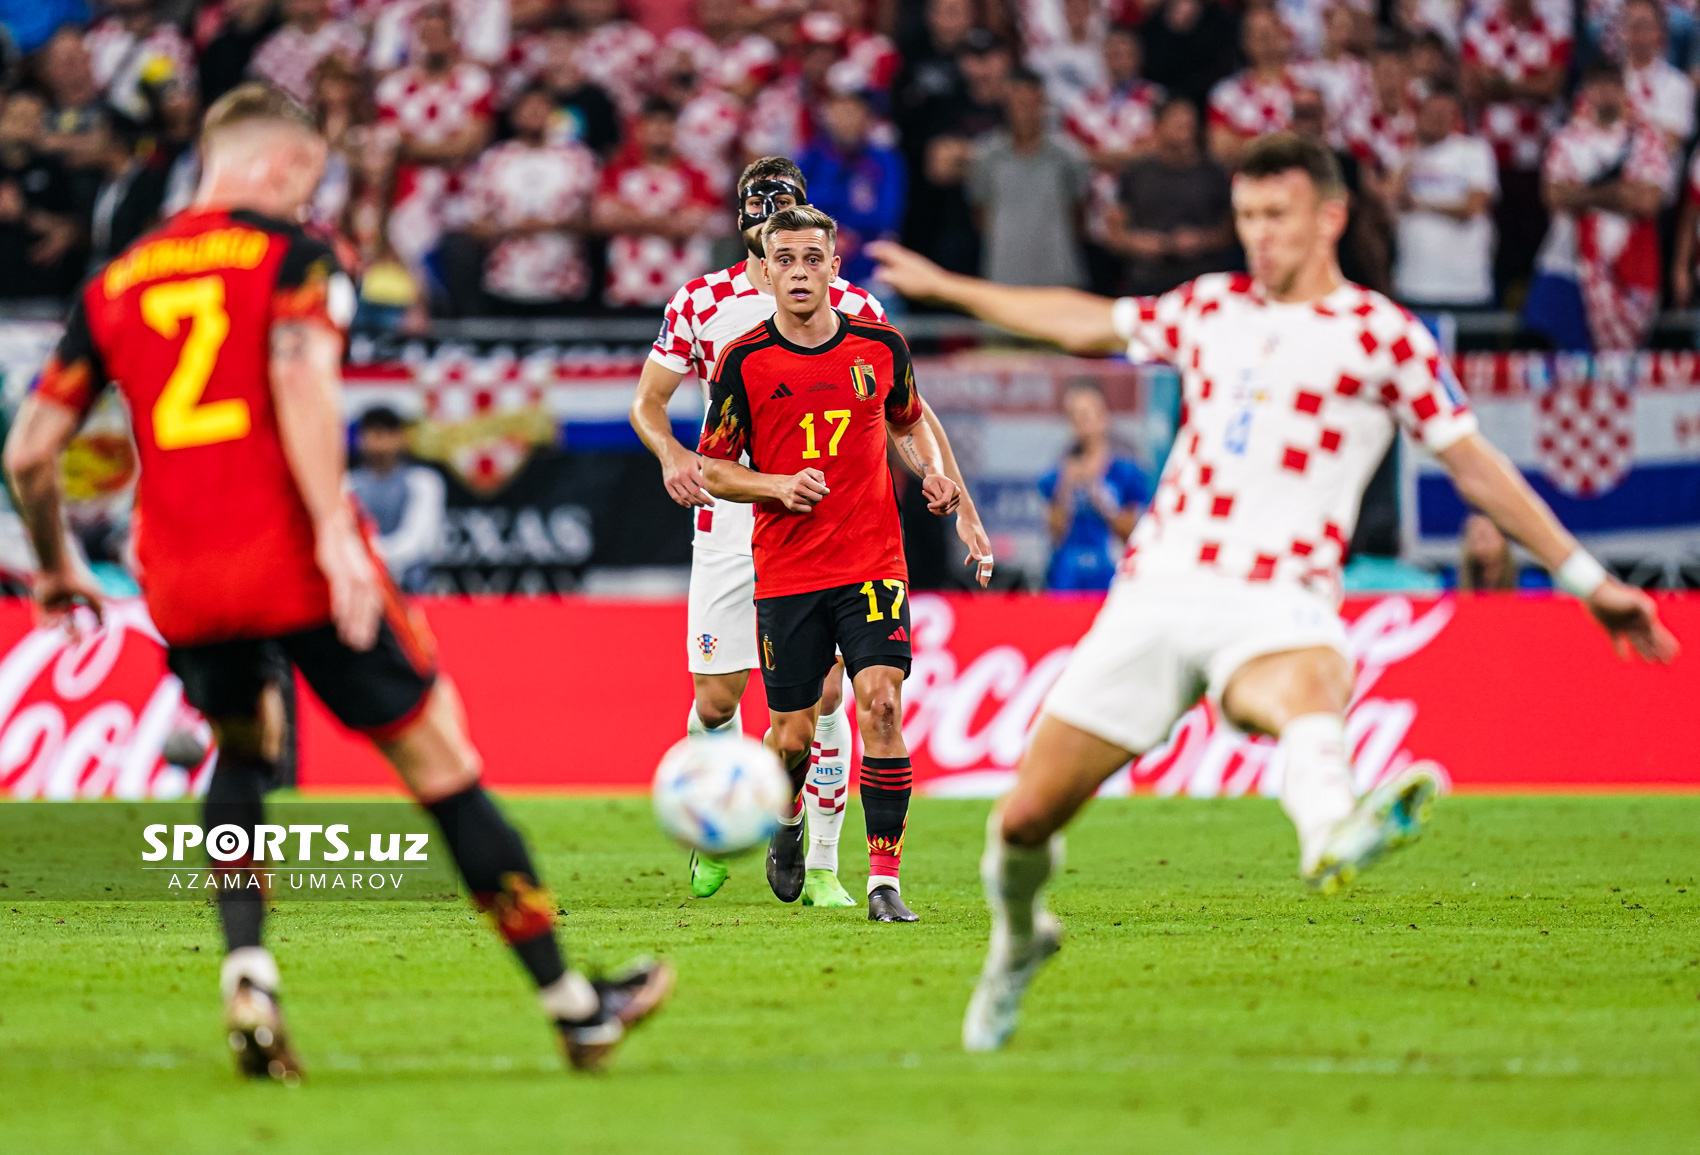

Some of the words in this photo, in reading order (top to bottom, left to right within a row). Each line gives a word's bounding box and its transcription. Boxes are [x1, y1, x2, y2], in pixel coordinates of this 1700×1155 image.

[139, 274, 251, 451] 2
[799, 409, 852, 459] 17
[859, 578, 906, 623] 17
[815, 765, 844, 777] HNS
